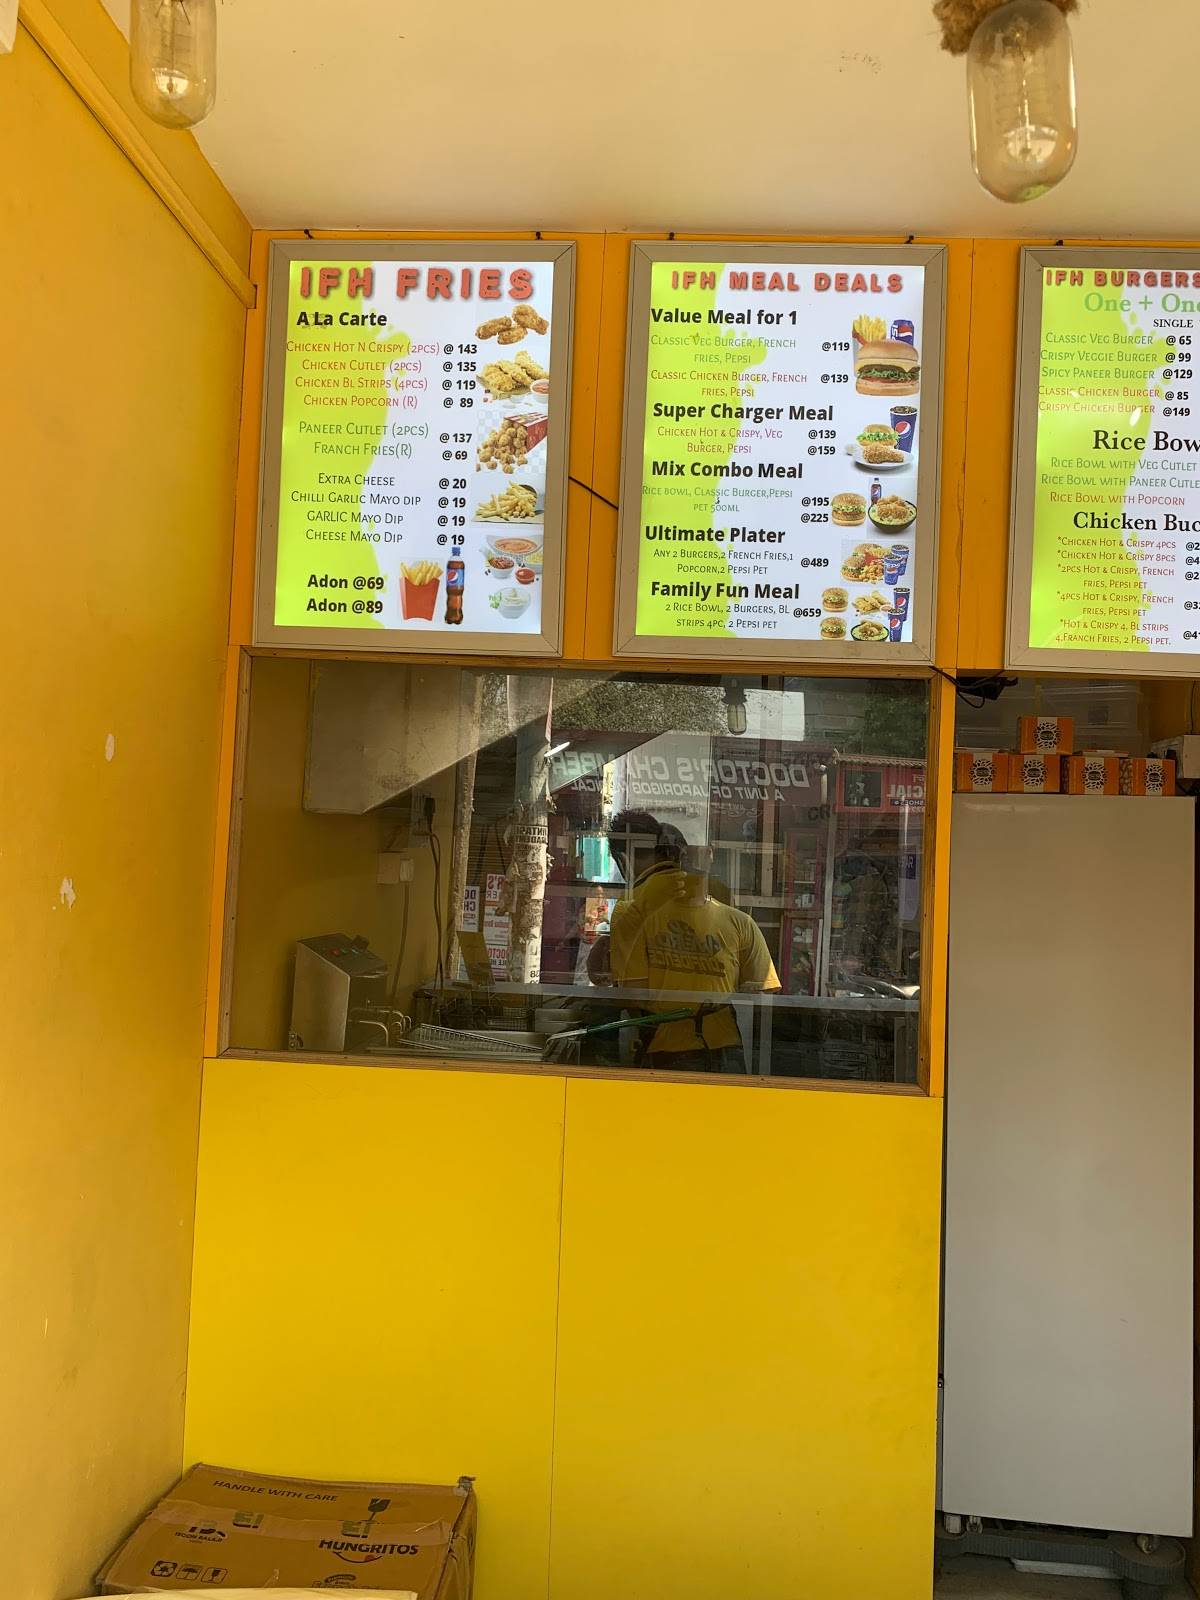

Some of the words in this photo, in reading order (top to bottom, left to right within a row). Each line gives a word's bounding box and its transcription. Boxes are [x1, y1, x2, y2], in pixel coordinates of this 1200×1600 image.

[300, 267, 373, 298] IFH
[396, 268, 534, 299] FRIES
[672, 271, 715, 289] IFH
[729, 272, 800, 291] MEAL
[814, 273, 904, 292] DEALS
[1046, 271, 1084, 286] IFH
[1084, 292, 1131, 312] One
[339, 312, 387, 326] Carte
[651, 309, 702, 323] Value
[707, 310, 751, 324] Meal
[757, 310, 782, 324] for
[785, 311, 797, 325] 1
[1153, 319, 1194, 328] SINGLE
[651, 335, 690, 346] CLASSIC
[692, 336, 711, 346] VEG
[714, 336, 756, 348] BURGER,
[758, 337, 796, 347] FRENCH
[822, 342, 849, 352] @119
[1046, 333, 1086, 344] CLASSIC
[1090, 333, 1109, 344] VEG
[1113, 334, 1153, 345] BURGER
[1179, 336, 1192, 345] 65
[287, 341, 331, 352] CHICKEN
[333, 342, 356, 352] HOT
[358, 343, 365, 352] N
[368, 342, 404, 353] CRISPY
[407, 342, 439, 355] (2PCS)
[457, 344, 477, 354] 143
[695, 354, 723, 364] FRIES,
[725, 353, 751, 363] PEPSI
[1040, 350, 1075, 361] CRISPY
[1078, 351, 1114, 361] VEGGIE
[1117, 351, 1157, 362] BURGER
[1178, 353, 1191, 362] 99
[302, 359, 346, 370] CHICKEN
[350, 360, 386, 371] CUTLET
[389, 360, 422, 373] (2PCS)
[457, 361, 476, 371] 135
[1042, 367, 1070, 377] SPICY
[1073, 368, 1110, 378] PANEER
[1115, 368, 1155, 379] BURGER
[1162, 369, 1192, 379] @129
[296, 377, 339, 388] CHICKEN
[343, 378, 355, 388] BL
[358, 378, 391, 389] STRIPS
[395, 378, 428, 391] (4PCS)
[456, 380, 476, 390] 119
[651, 370, 686, 380] CLASSIC
[690, 371, 729, 381] CHICKEN
[731, 371, 769, 383] BURGER,
[772, 372, 807, 383] FRENCH
[821, 374, 848, 384] @139
[702, 388, 727, 399] FRIES,
[730, 388, 754, 398] PEPSI
[304, 395, 347, 406] CHICKEN
[351, 396, 399, 407] POPCORN
[403, 396, 418, 409] (R)
[460, 398, 473, 407] 89
[653, 403, 705, 421] Super
[710, 404, 783, 423] Charger
[789, 405, 833, 420] Meal
[1163, 407, 1190, 416] @149
[299, 422, 342, 434] PANEER
[346, 423, 388, 435] CUTLET
[392, 423, 429, 437] (2PCS)
[453, 433, 472, 443] 137
[658, 427, 696, 437] CHICKEN
[700, 428, 719, 437] HOT
[729, 428, 762, 439] CRISPY,
[765, 429, 782, 438] VEG
[808, 429, 836, 439] @139
[1093, 430, 1145, 450] Rice
[1153, 431, 1200, 450] Bow
[314, 442, 360, 455] FRANCH
[364, 444, 412, 458] FRIES(R)
[455, 450, 467, 460] 69
[687, 443, 724, 455] BURGER,
[727, 443, 751, 453] PEPSI
[808, 445, 836, 455] @159
[652, 461, 685, 476] Mix
[690, 462, 753, 477] Combo
[758, 463, 803, 478] Meal
[1051, 457, 1072, 467] RICE
[1077, 458, 1105, 468] BOWL
[1110, 460, 1135, 469] WITH
[1139, 460, 1158, 470] VEG
[1161, 460, 1197, 471] CUTLET
[318, 473, 351, 485] EXTRA
[354, 474, 395, 486] CHEESE
[452, 478, 466, 489] 20
[1042, 474, 1064, 484] RICE
[1067, 475, 1096, 485] BOWL
[1100, 477, 1126, 486] WITH
[1130, 476, 1166, 487] PANEER
[291, 491, 324, 502] CHILLI
[328, 492, 366, 503] GARLIC
[370, 494, 400, 504] MAYO
[403, 495, 420, 505] DIP
[452, 497, 466, 508] 19
[802, 497, 829, 506] @195
[1051, 492, 1072, 502] RICE
[1076, 493, 1104, 503] BOWL
[1108, 495, 1135, 503] WITH
[1138, 494, 1185, 505] POPCORN
[307, 511, 347, 522] GARLIC
[351, 512, 381, 523] MAYO
[385, 513, 403, 524] DIP
[452, 516, 465, 526] 19
[801, 514, 829, 522] @225
[1074, 512, 1156, 530] Chicken
[1164, 514, 1200, 531] Buc
[306, 529, 346, 541] CHEESE
[350, 531, 380, 542] MAYO
[384, 532, 403, 543] DIP
[451, 534, 464, 544] 19
[645, 525, 725, 541] Ultimate
[730, 527, 785, 543] Plater
[1100, 538, 1116, 546] HOT
[1126, 539, 1154, 548] CRISPY
[1156, 541, 1176, 549] 4PCS
[728, 550, 761, 560] FRENCH
[801, 558, 829, 567] @489
[728, 565, 750, 574] PEPSI
[753, 565, 768, 574] PET
[307, 575, 348, 588] Adon
[353, 577, 384, 591] @69
[651, 582, 711, 601] Family
[716, 583, 748, 598] Fun
[754, 584, 799, 599] Meal
[306, 598, 347, 612] Adon
[352, 600, 383, 614] @89
[673, 603, 692, 611] RICE
[695, 603, 724, 613] BOWL,
[734, 604, 775, 614] BURGERS,
[793, 608, 821, 618] @659
[676, 619, 704, 627] STRIPS
[736, 619, 760, 628] PEPSI
[214, 1480, 264, 1495] HANDLE
[268, 1489, 301, 1498] WITH
[304, 1492, 339, 1502] CARE
[319, 1539, 418, 1555] HUNGRITOS
